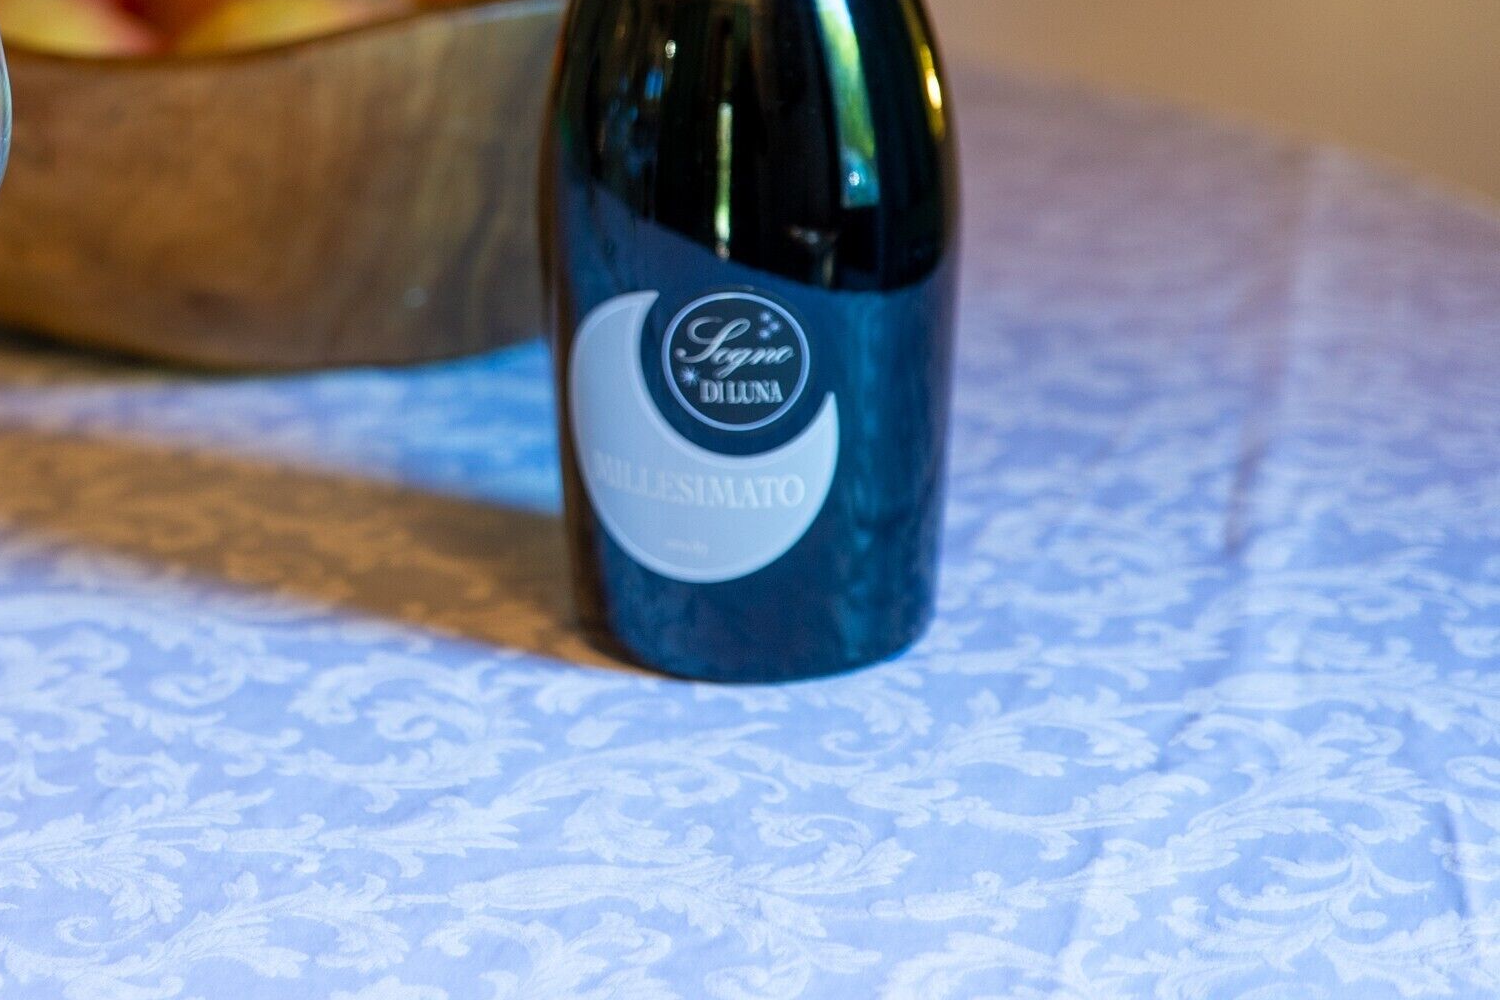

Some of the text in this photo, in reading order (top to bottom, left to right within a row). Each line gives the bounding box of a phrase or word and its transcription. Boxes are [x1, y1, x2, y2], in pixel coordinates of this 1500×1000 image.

[699, 379, 783, 404] DI LUNA
[593, 451, 806, 509] MILLESIMATO
